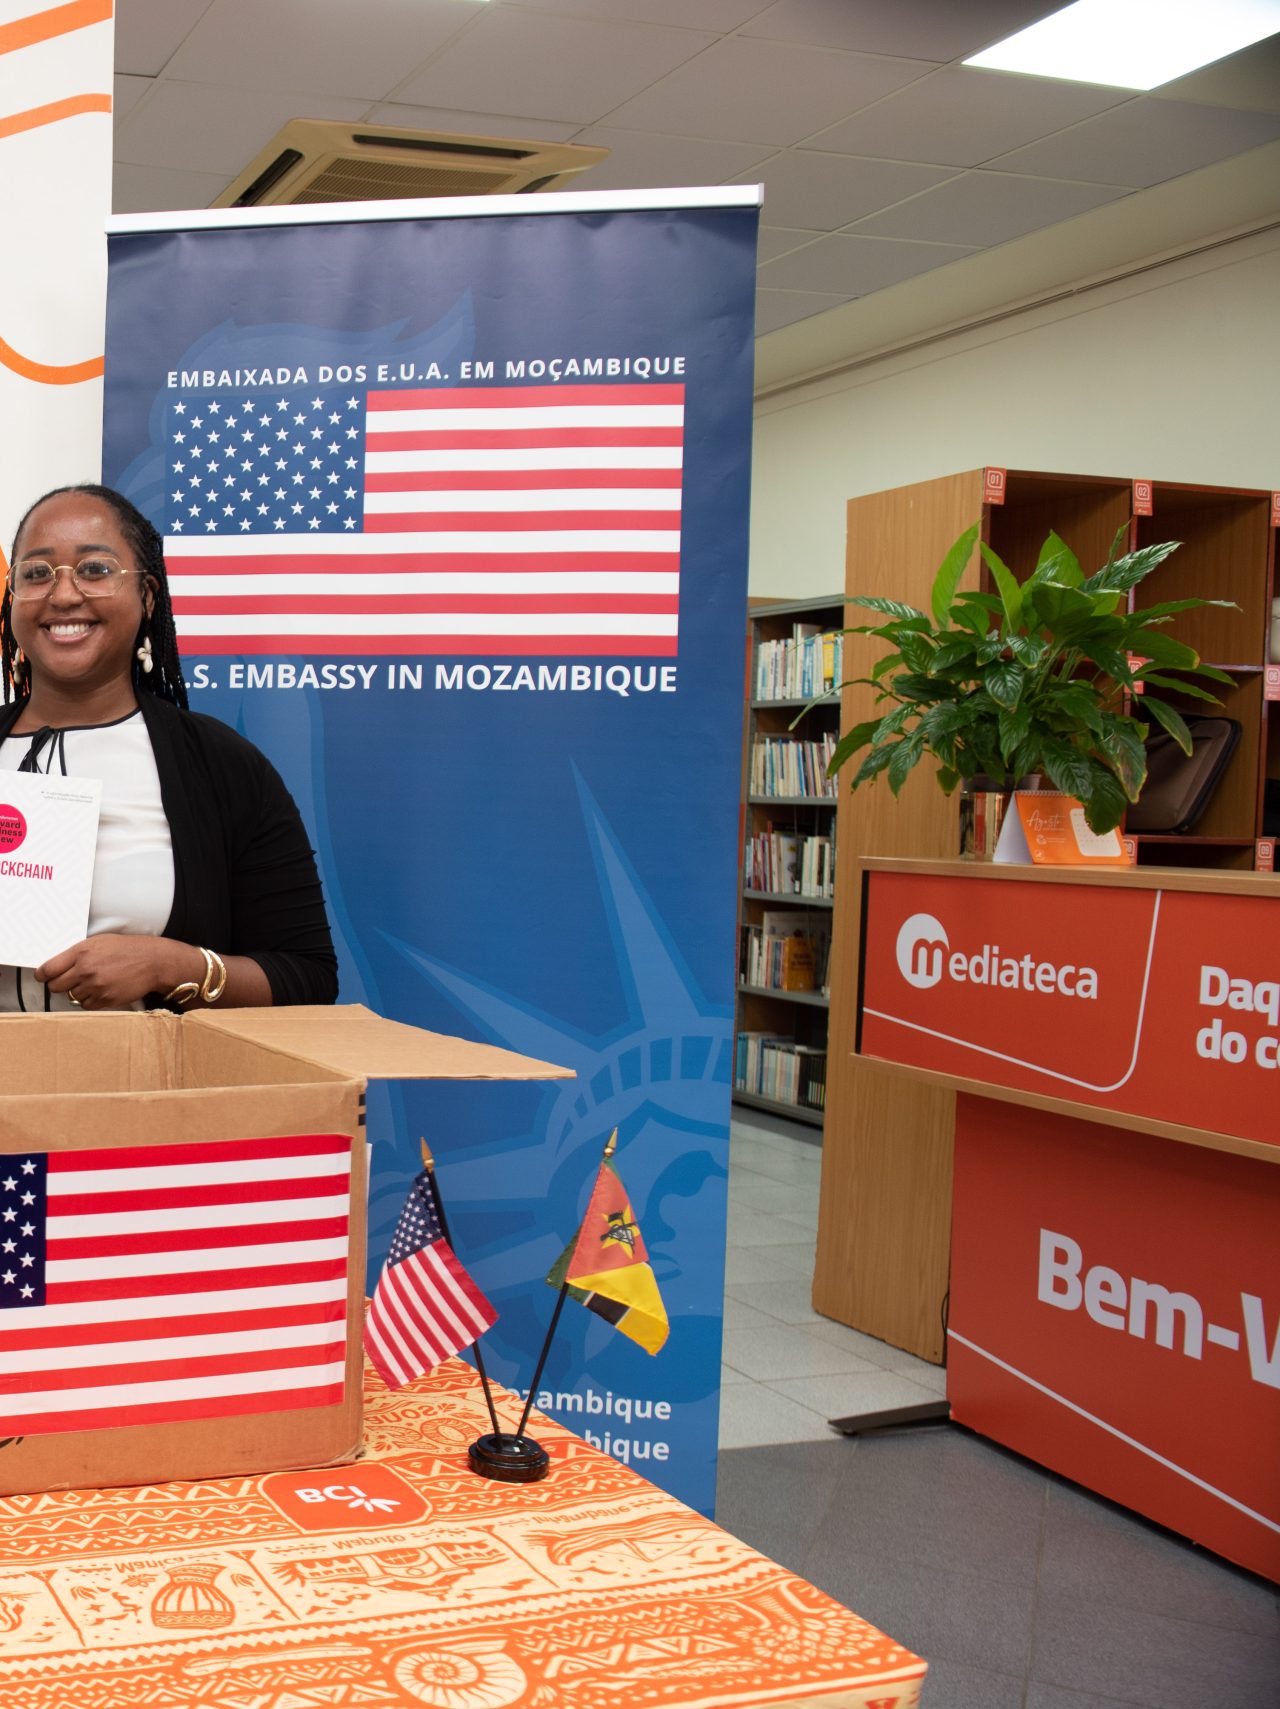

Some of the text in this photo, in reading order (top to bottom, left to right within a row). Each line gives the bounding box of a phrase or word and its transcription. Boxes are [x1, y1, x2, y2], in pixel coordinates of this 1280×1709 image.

[167, 357, 686, 388] EMBAIXADA DOS E.U.A. EM MOÇAMBIQUE
[185, 664, 678, 697] .S. EMBASSY IN MOZAMBIQUE
[1199, 965, 1280, 1027] Daq
[1196, 1018, 1280, 1070] do c
[294, 1485, 368, 1504] BCI
